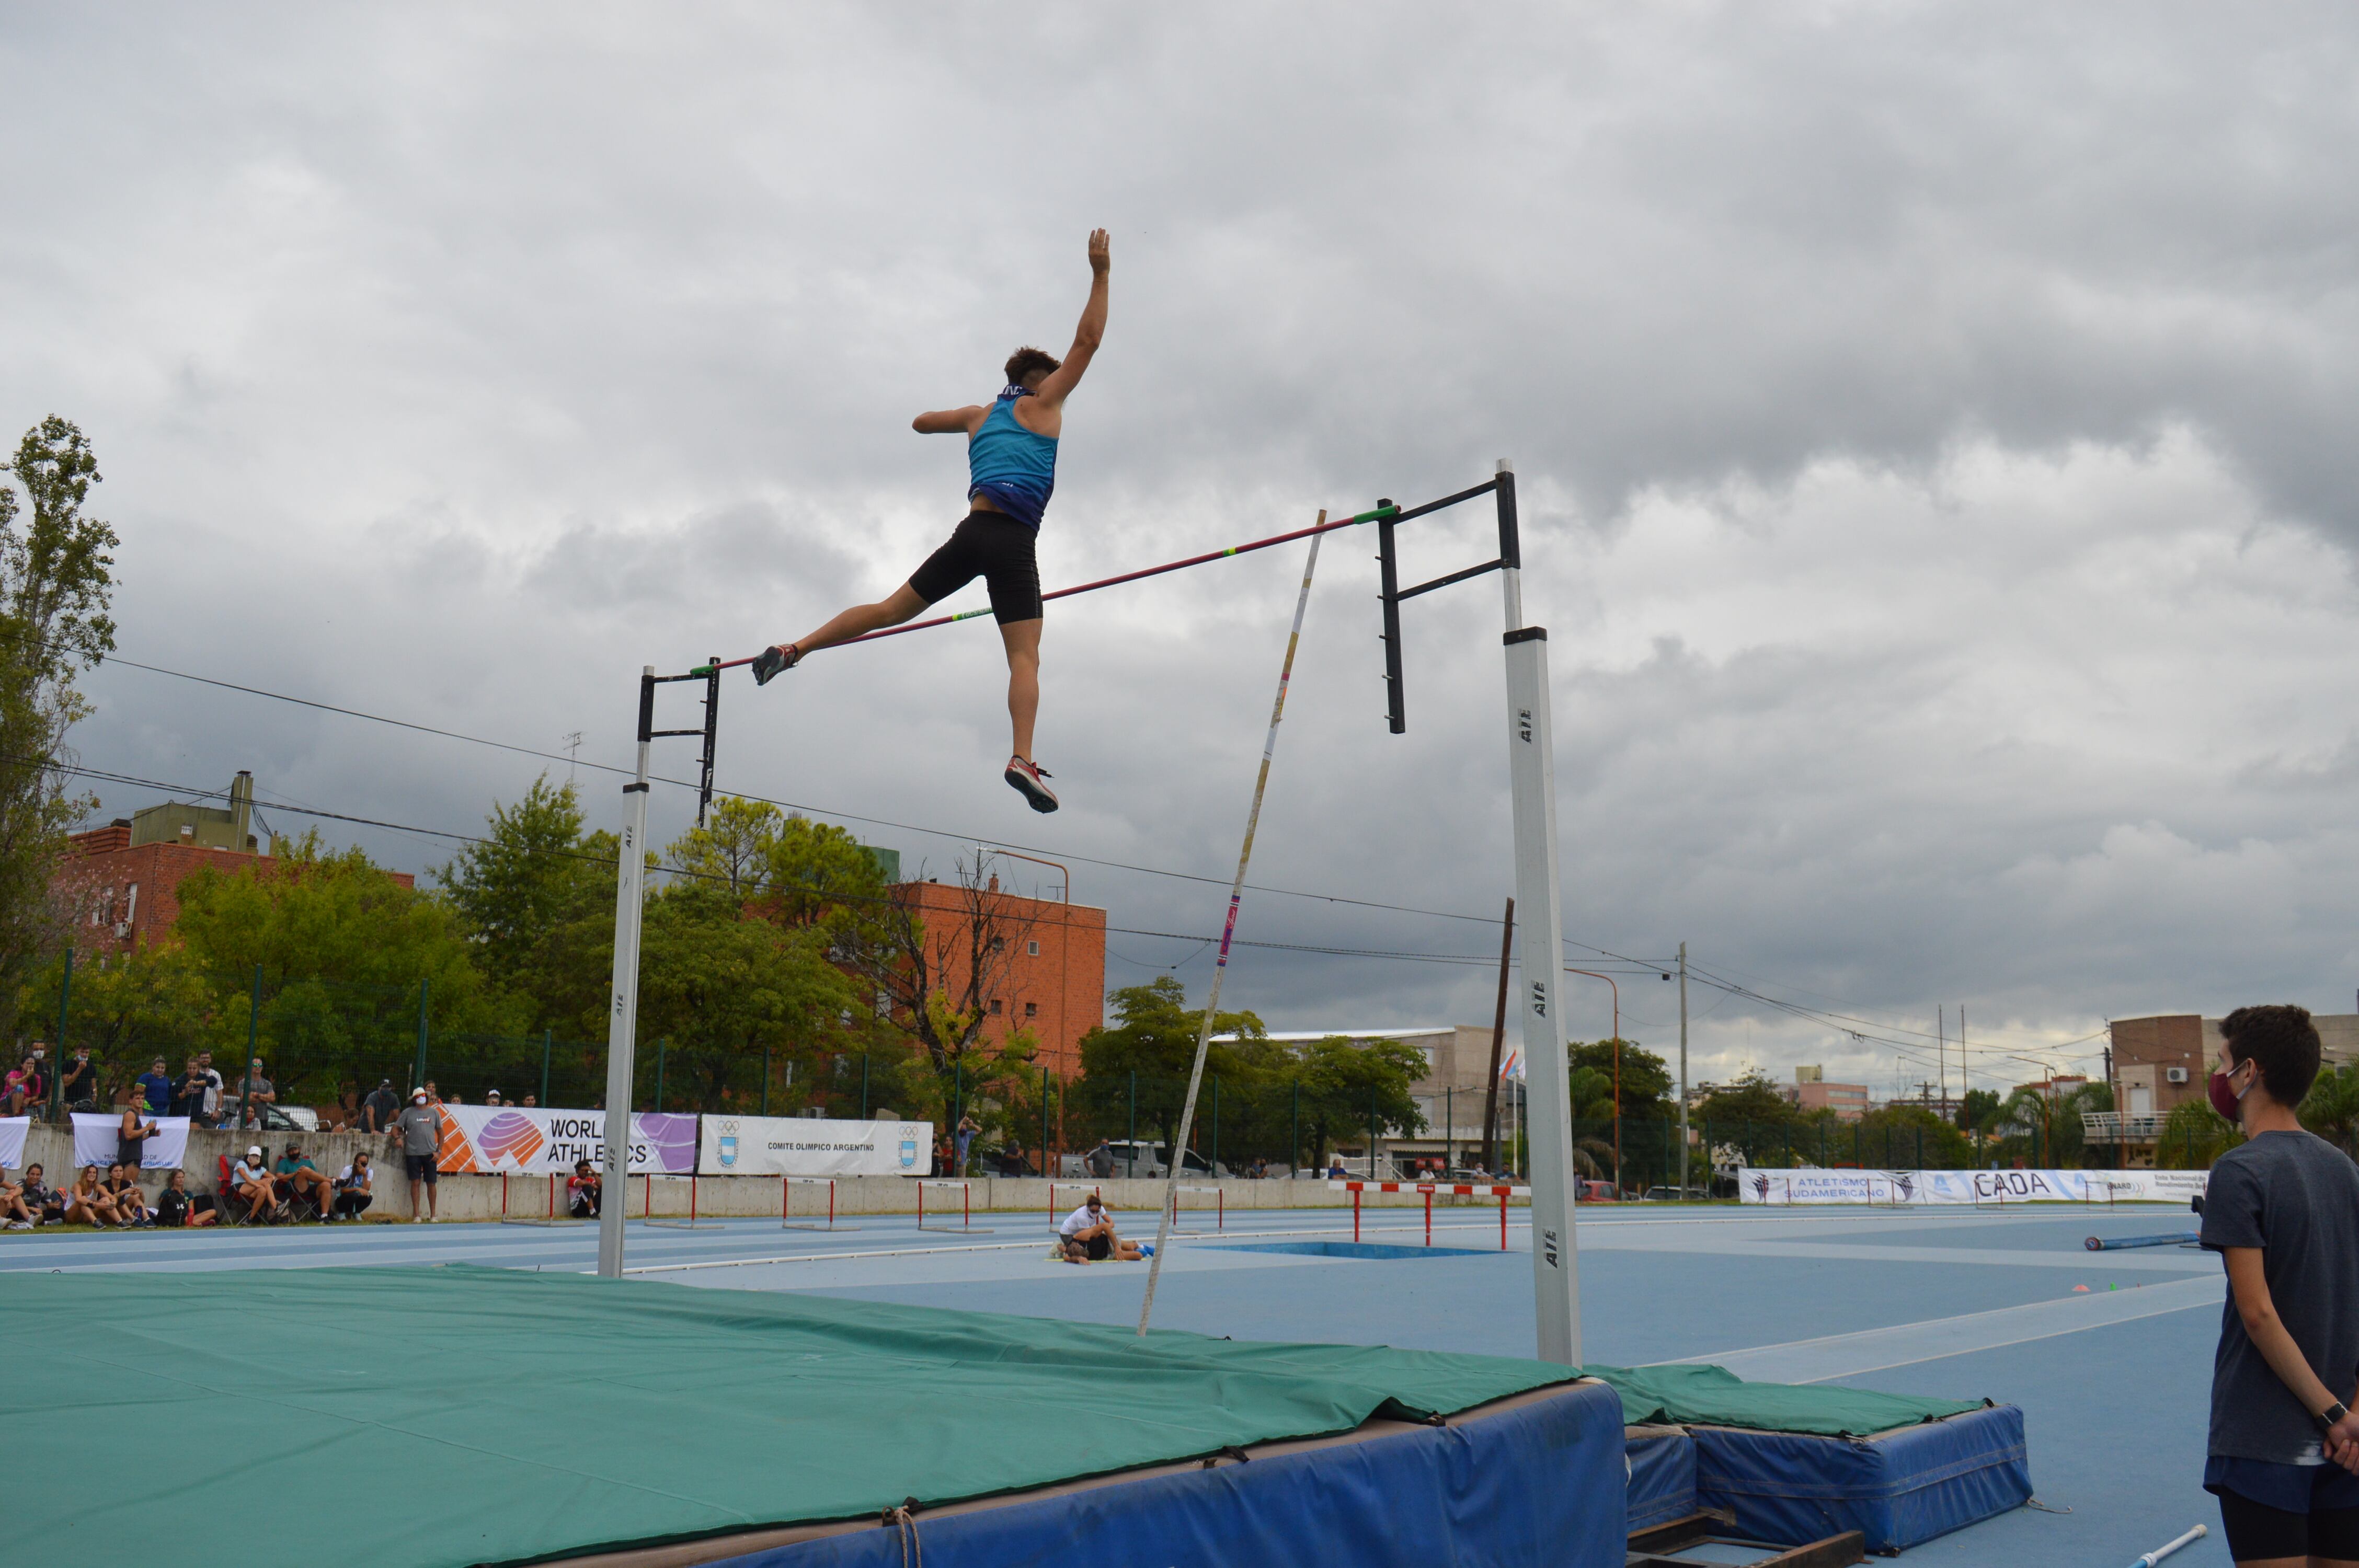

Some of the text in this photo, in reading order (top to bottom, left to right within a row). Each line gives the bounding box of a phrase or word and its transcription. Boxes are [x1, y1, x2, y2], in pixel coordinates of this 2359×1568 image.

[551, 1119, 605, 1138] WORL
[547, 1144, 647, 1163] ATHLES
[1799, 1178, 1868, 1186] ATLETISMO
[1975, 1173, 2051, 1197] CADA
[1784, 1189, 1884, 1198] SUDAMERICANO
